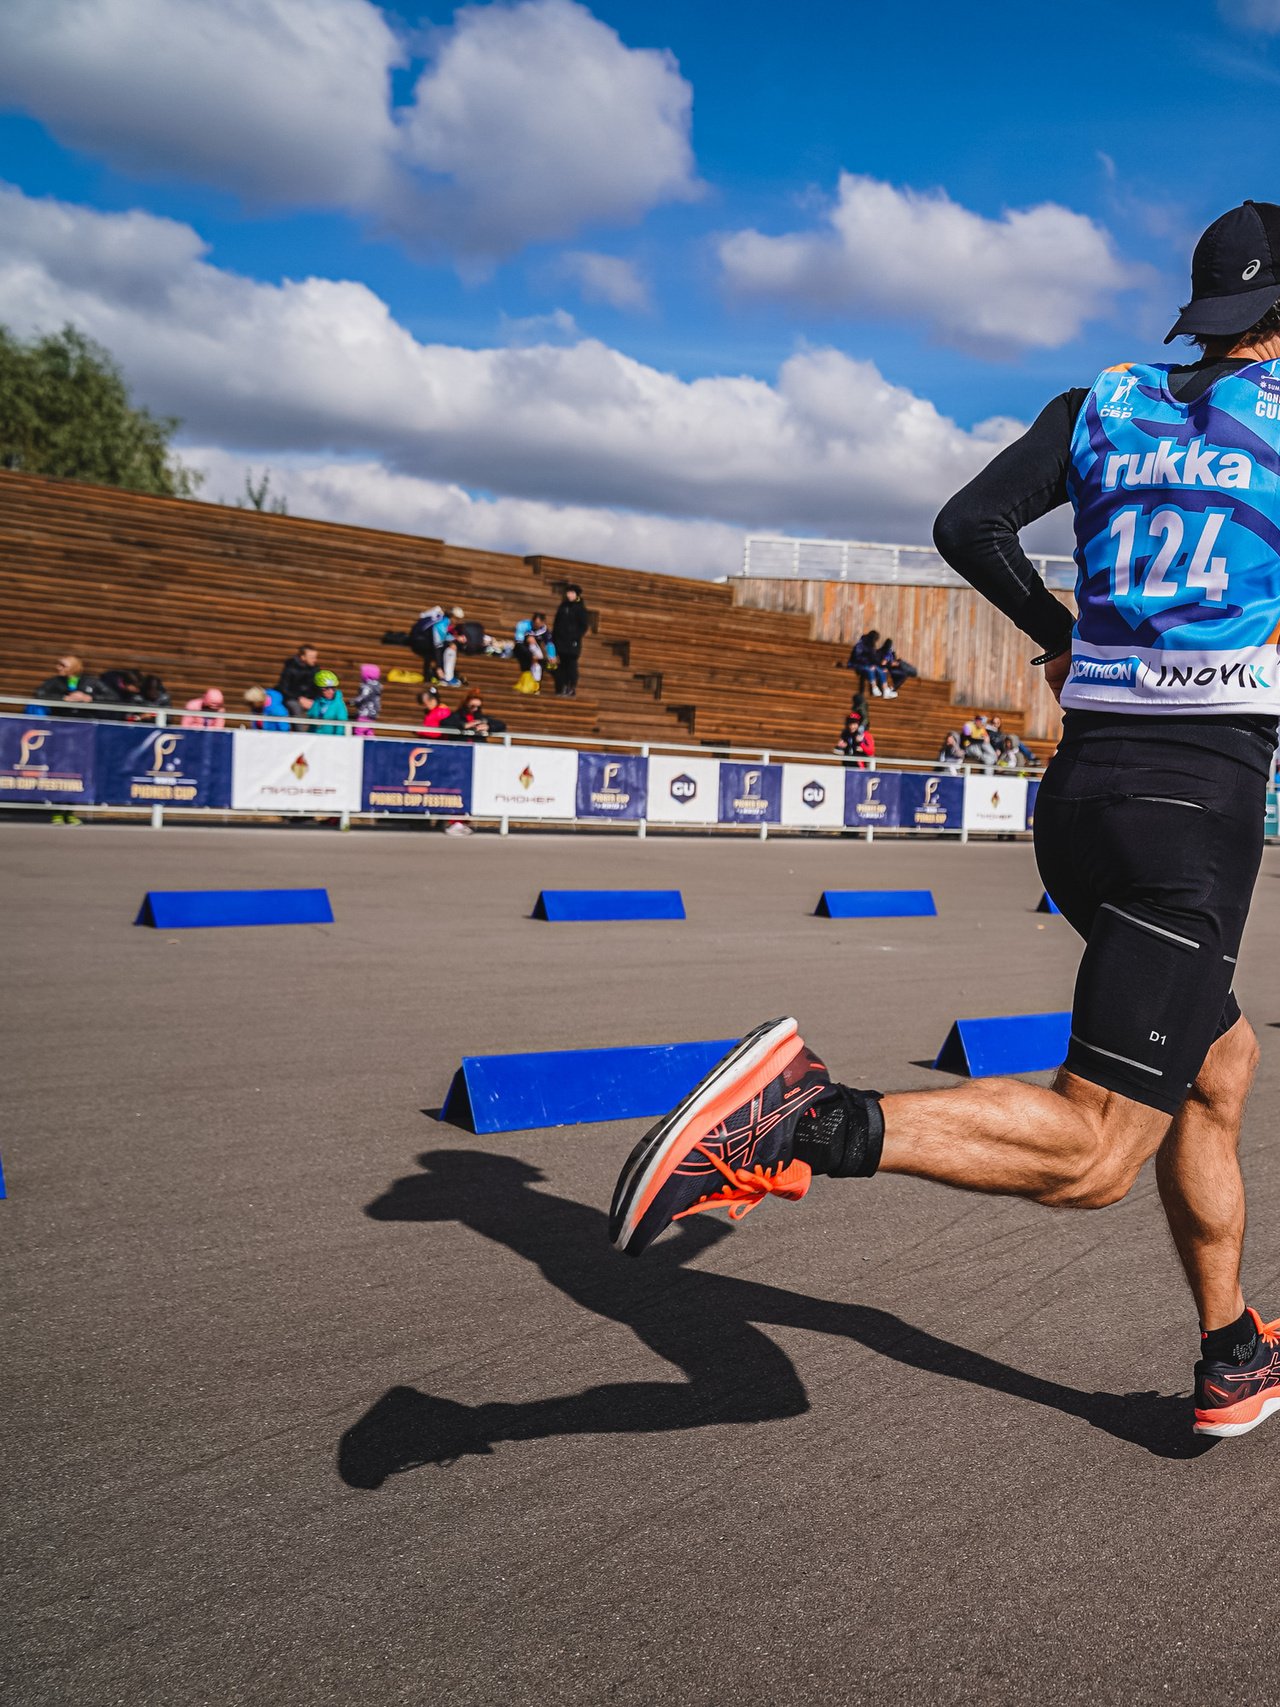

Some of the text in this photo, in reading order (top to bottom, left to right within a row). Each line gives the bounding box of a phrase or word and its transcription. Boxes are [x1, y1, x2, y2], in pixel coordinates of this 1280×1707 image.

[1105, 440, 1252, 489] rukka
[1110, 510, 1229, 601] 124
[1149, 1031, 1166, 1045] D1
